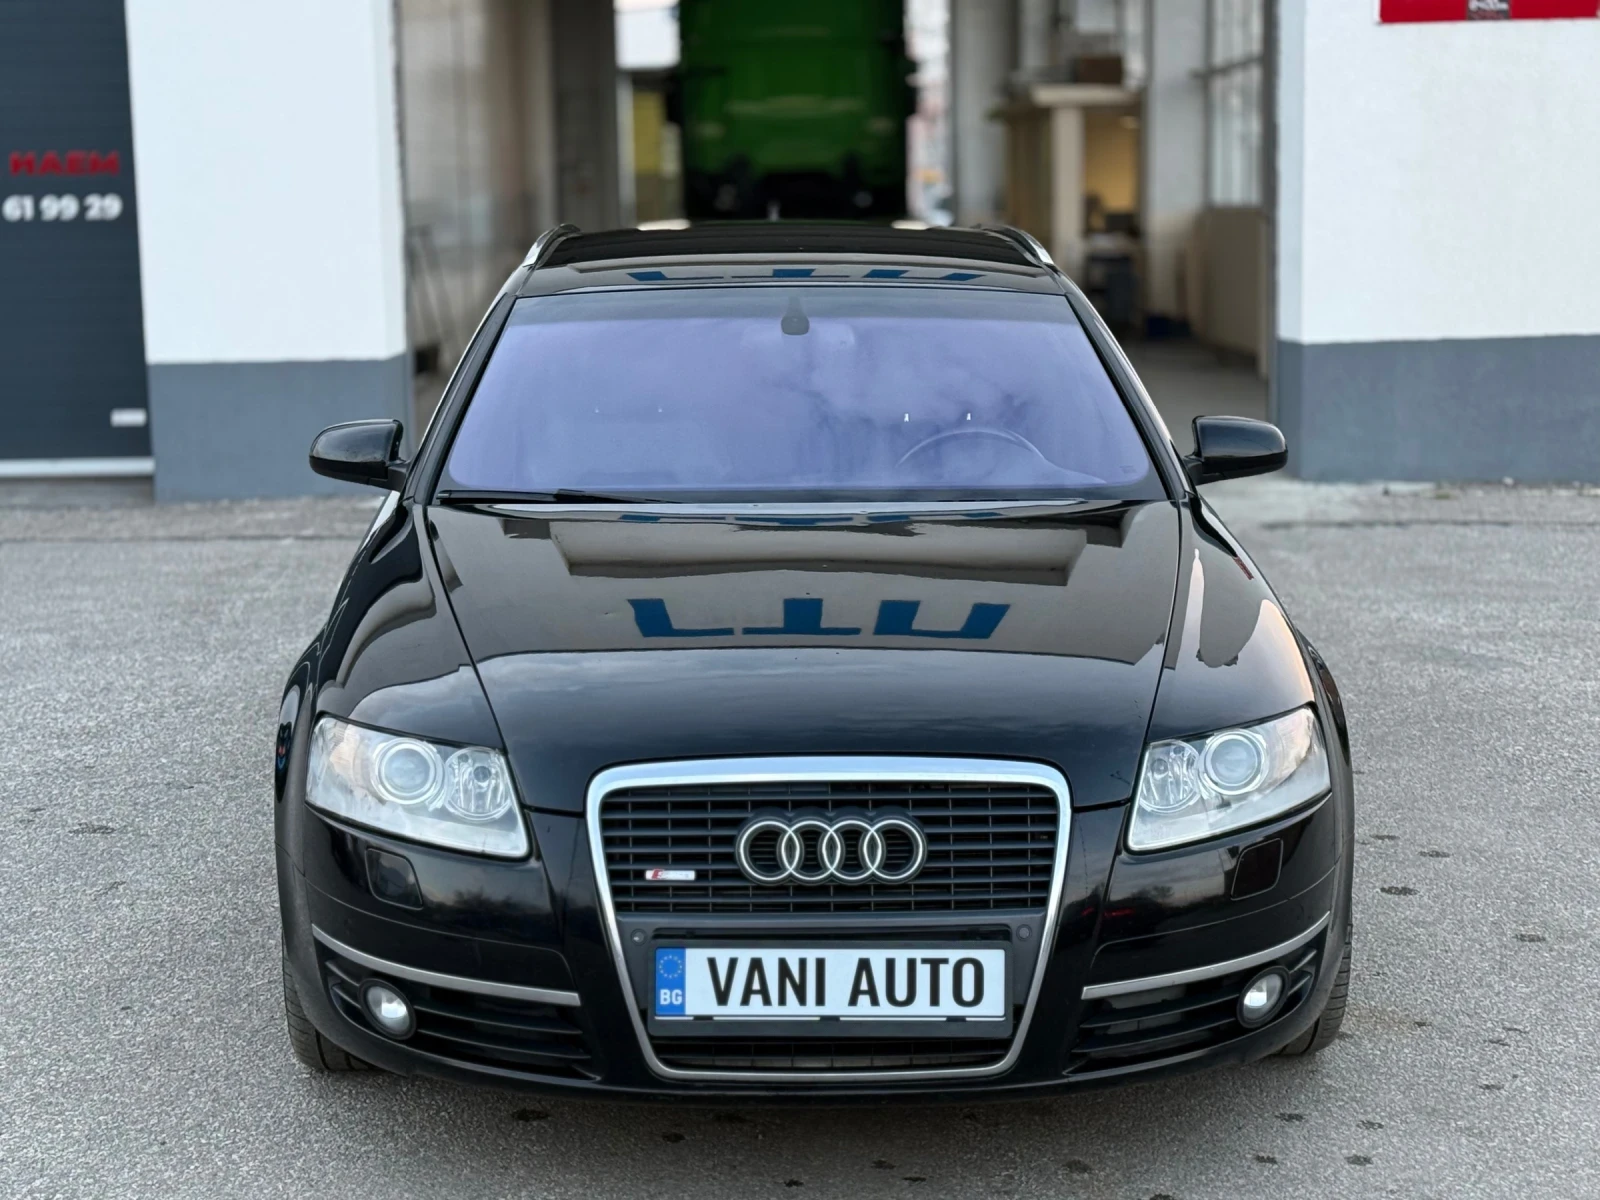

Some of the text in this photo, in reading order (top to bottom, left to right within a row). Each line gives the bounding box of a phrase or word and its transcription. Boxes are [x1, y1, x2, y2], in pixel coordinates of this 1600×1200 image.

[659, 988, 684, 1006] BG
[706, 957, 984, 1008] VANI AUTO
